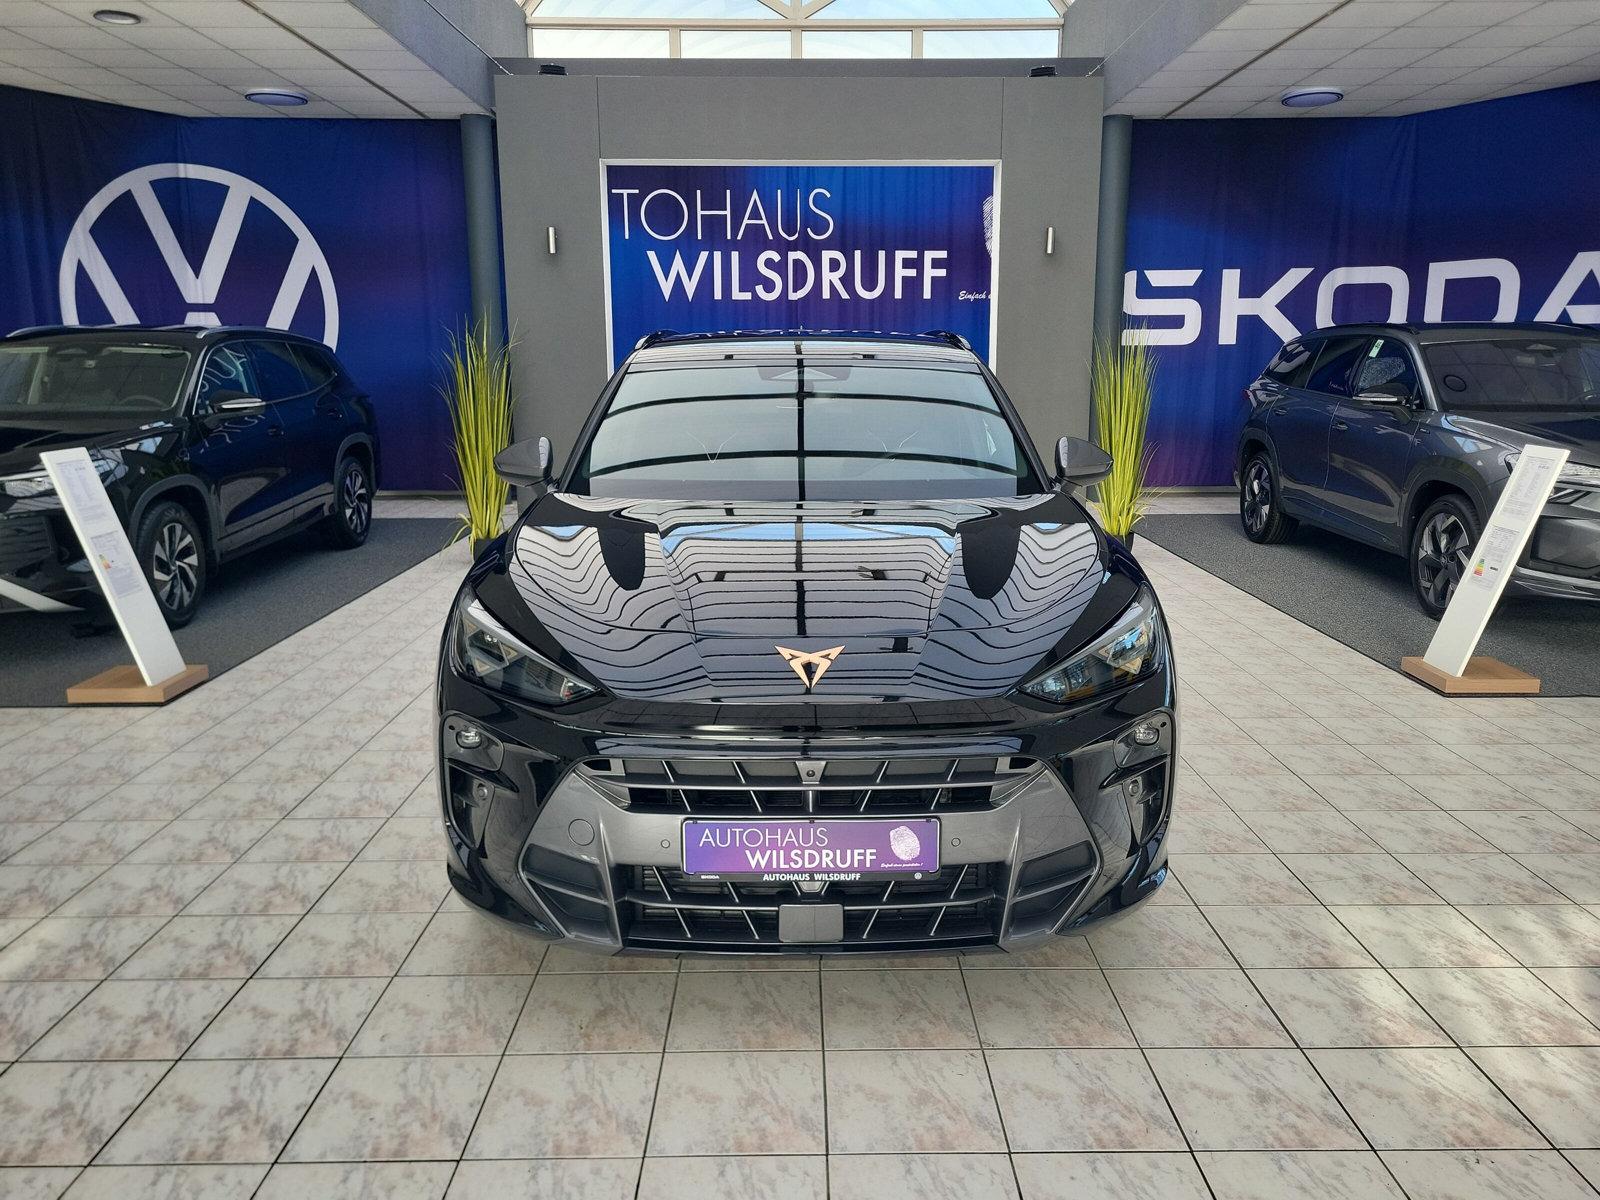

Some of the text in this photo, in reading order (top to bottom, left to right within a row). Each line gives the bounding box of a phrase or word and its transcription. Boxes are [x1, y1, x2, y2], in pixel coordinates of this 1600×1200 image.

[611, 188, 834, 241] TOHAUS
[646, 250, 948, 302] WILSDRUFF
[958, 290, 987, 302] Einfach
[699, 827, 828, 848] AUTOHAUS
[745, 848, 877, 870] WILSDRUFF
[763, 872, 861, 881] AUTOHAUS WILSDRUFF
